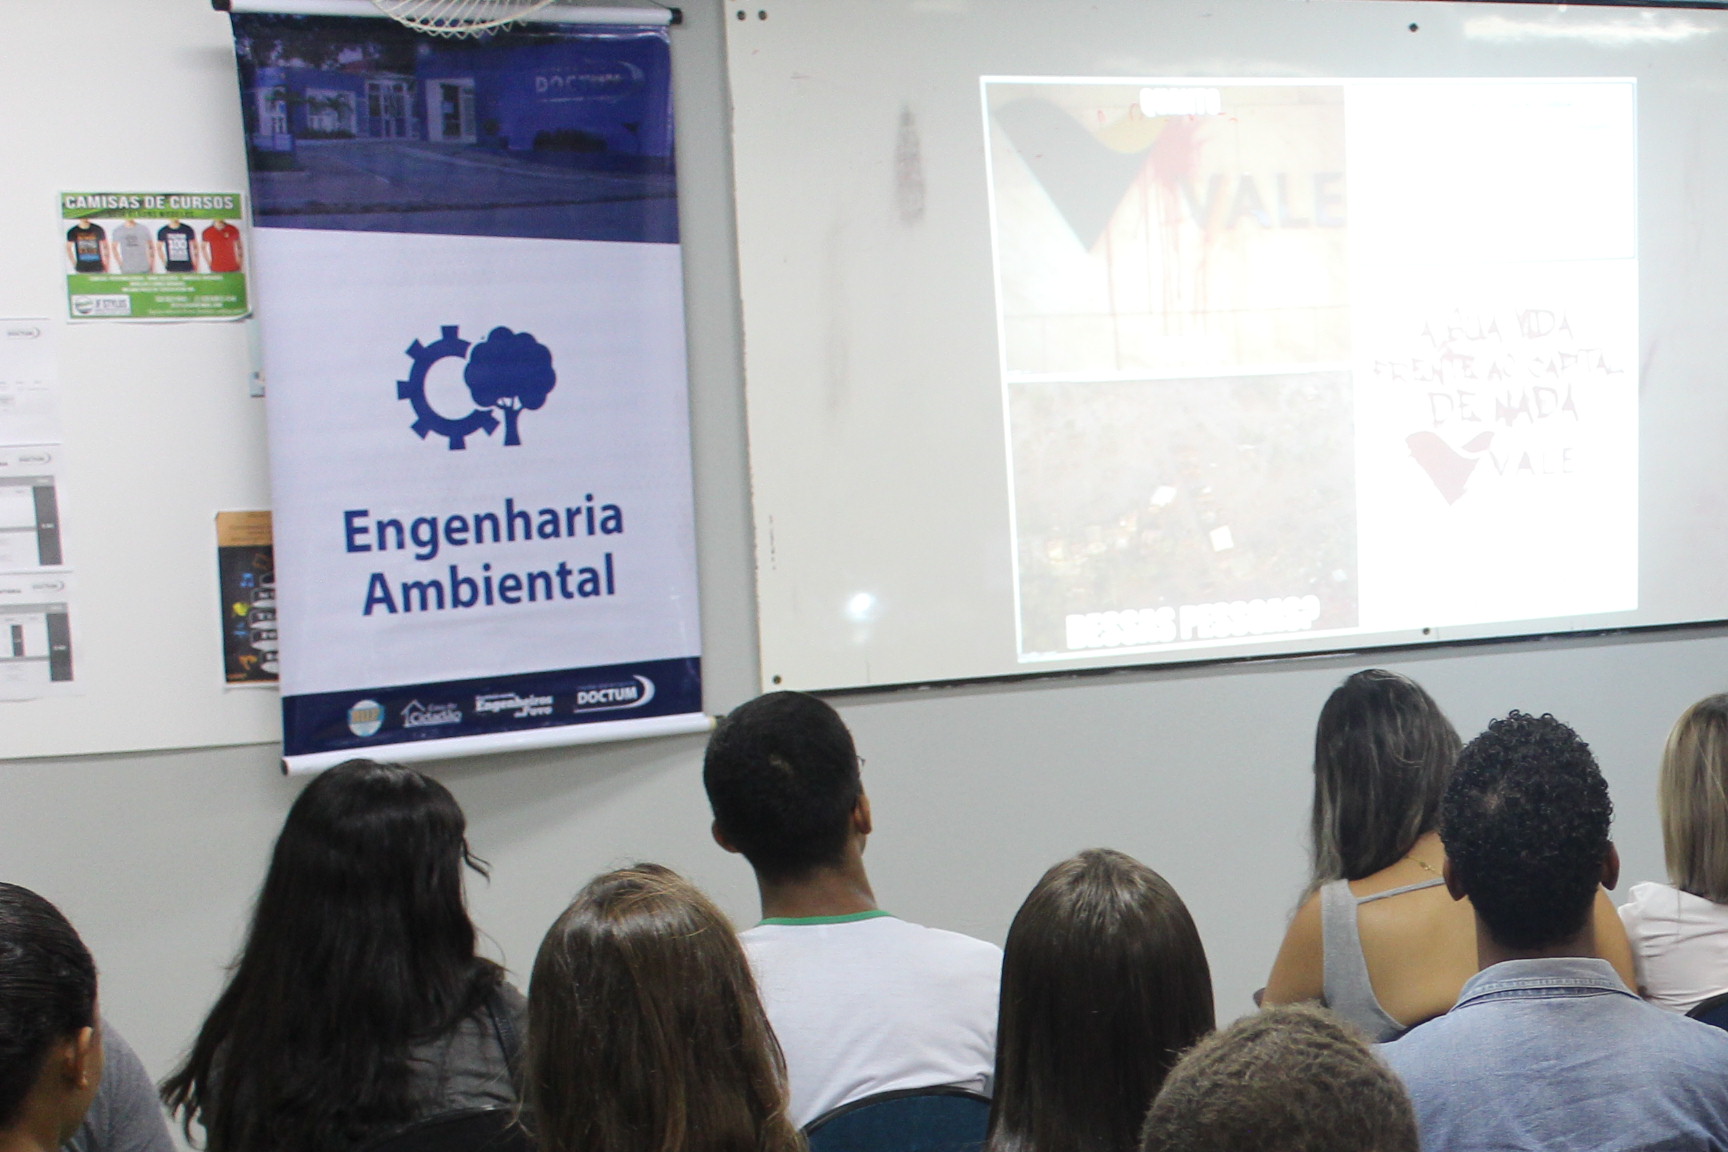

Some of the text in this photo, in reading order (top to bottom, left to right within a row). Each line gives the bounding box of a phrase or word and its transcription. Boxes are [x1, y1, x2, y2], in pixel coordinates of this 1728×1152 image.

[65, 195, 234, 210] CAMISAS DE CURSOS
[1178, 171, 1347, 231] VALE
[1515, 308, 1574, 340] VIDA
[1427, 383, 1580, 427] DE NADA
[1489, 447, 1575, 476] VALE
[343, 493, 624, 561] Engenharia
[363, 552, 615, 616] Ambiental
[577, 686, 638, 704] DOCTUM
